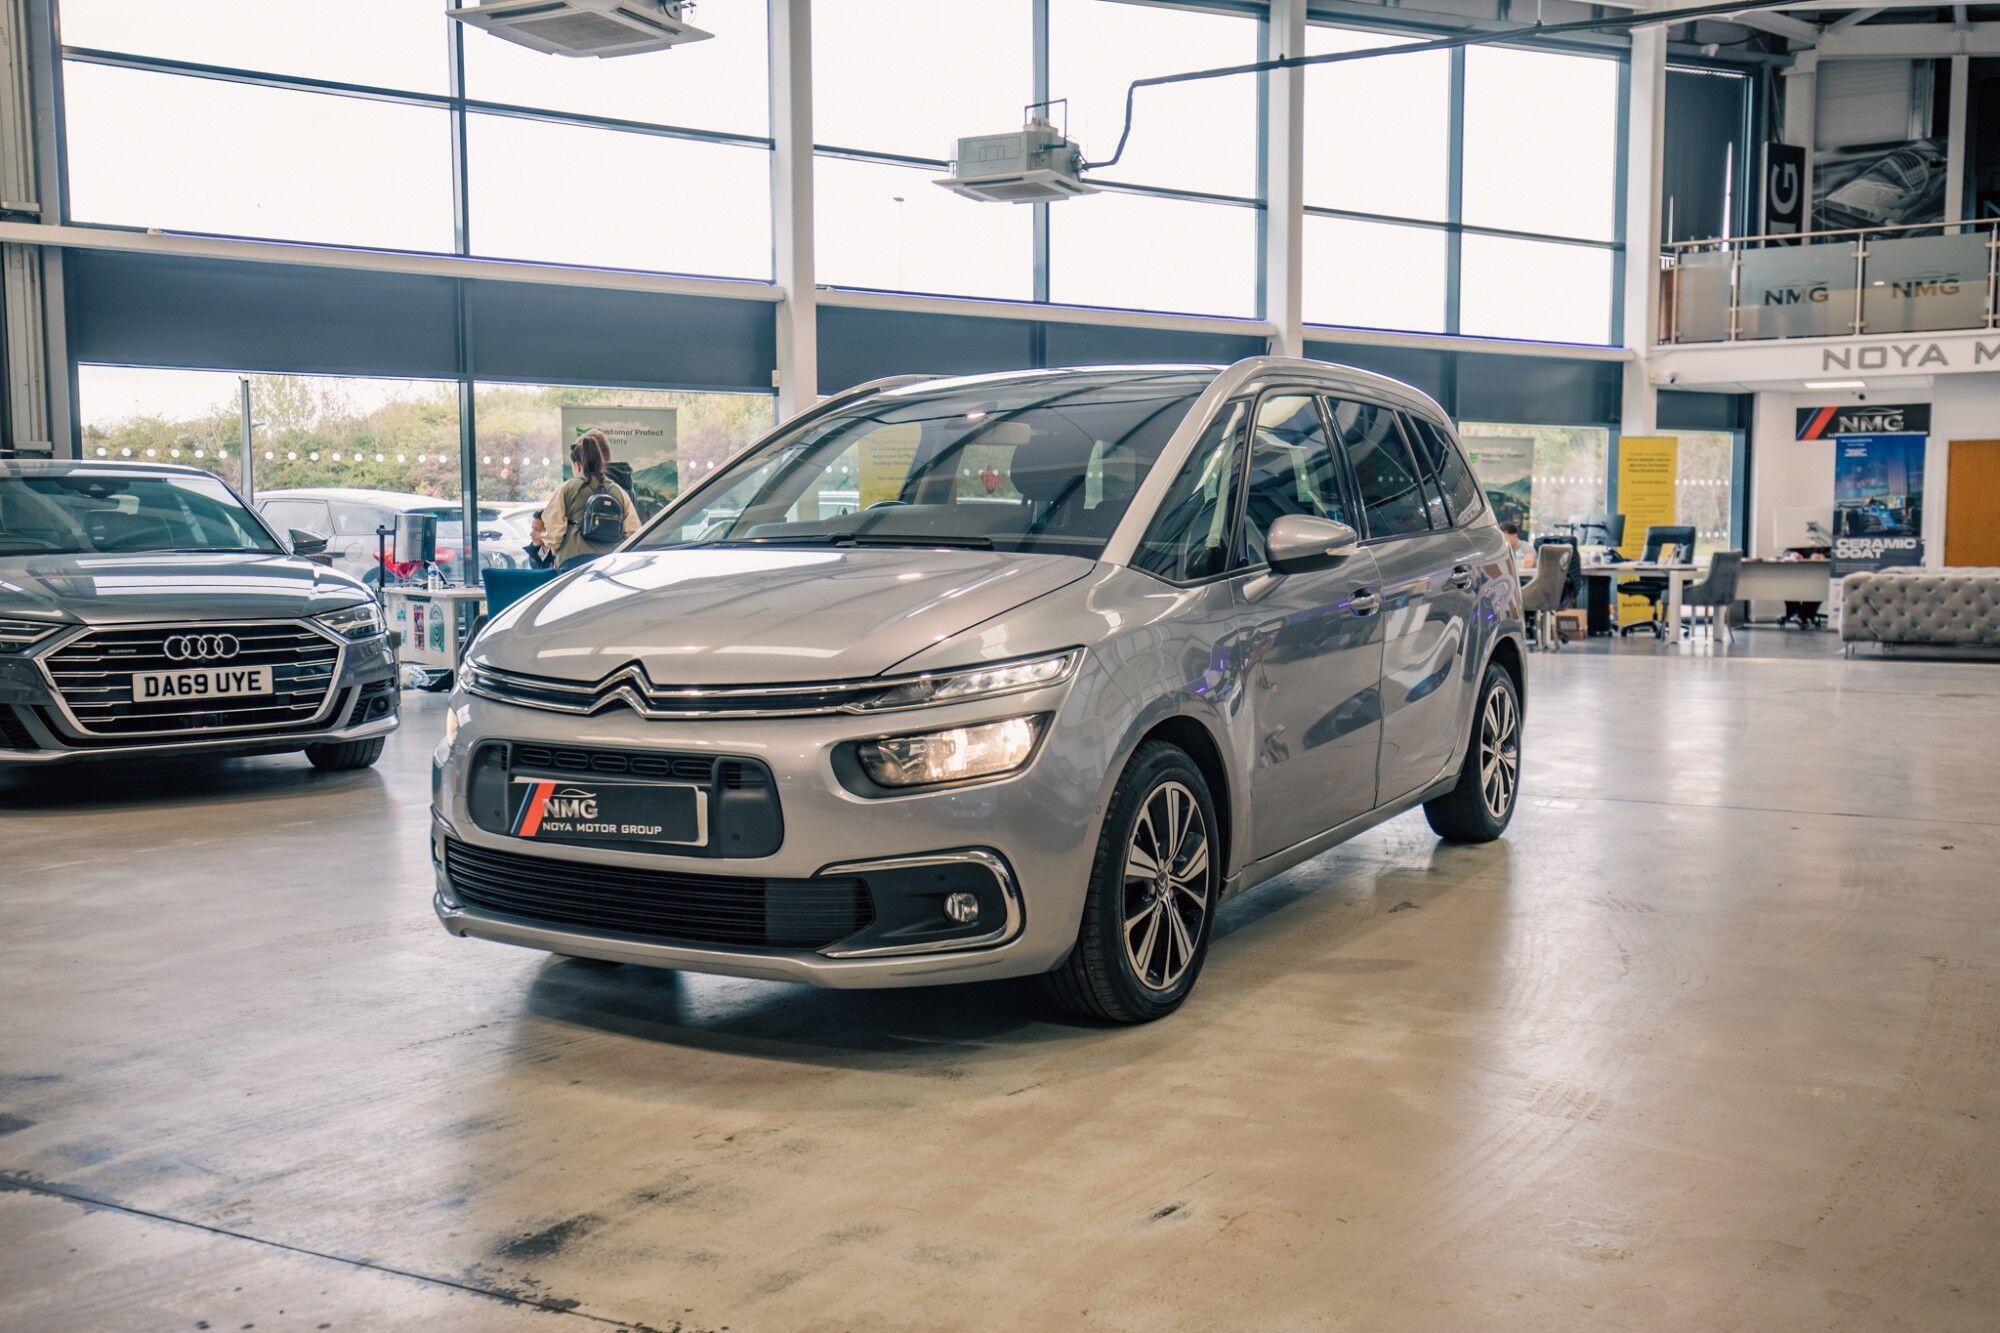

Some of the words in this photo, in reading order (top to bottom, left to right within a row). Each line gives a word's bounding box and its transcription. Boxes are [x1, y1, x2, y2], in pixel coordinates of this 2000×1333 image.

[1764, 286, 1830, 306] NMG
[1892, 278, 1960, 299] NMG
[1822, 343, 1949, 371] NOYA
[1838, 414, 1905, 432] NMG
[635, 429, 664, 437] Protect
[1836, 538, 1917, 549] CERAMIC
[1835, 548, 1885, 559] COAT
[144, 674, 209, 697] DA69
[215, 671, 262, 693] UYE
[542, 798, 599, 819] NMG
[542, 822, 573, 832] NOYA
[576, 823, 617, 834] MOTOR
[621, 824, 663, 836] GROUP
